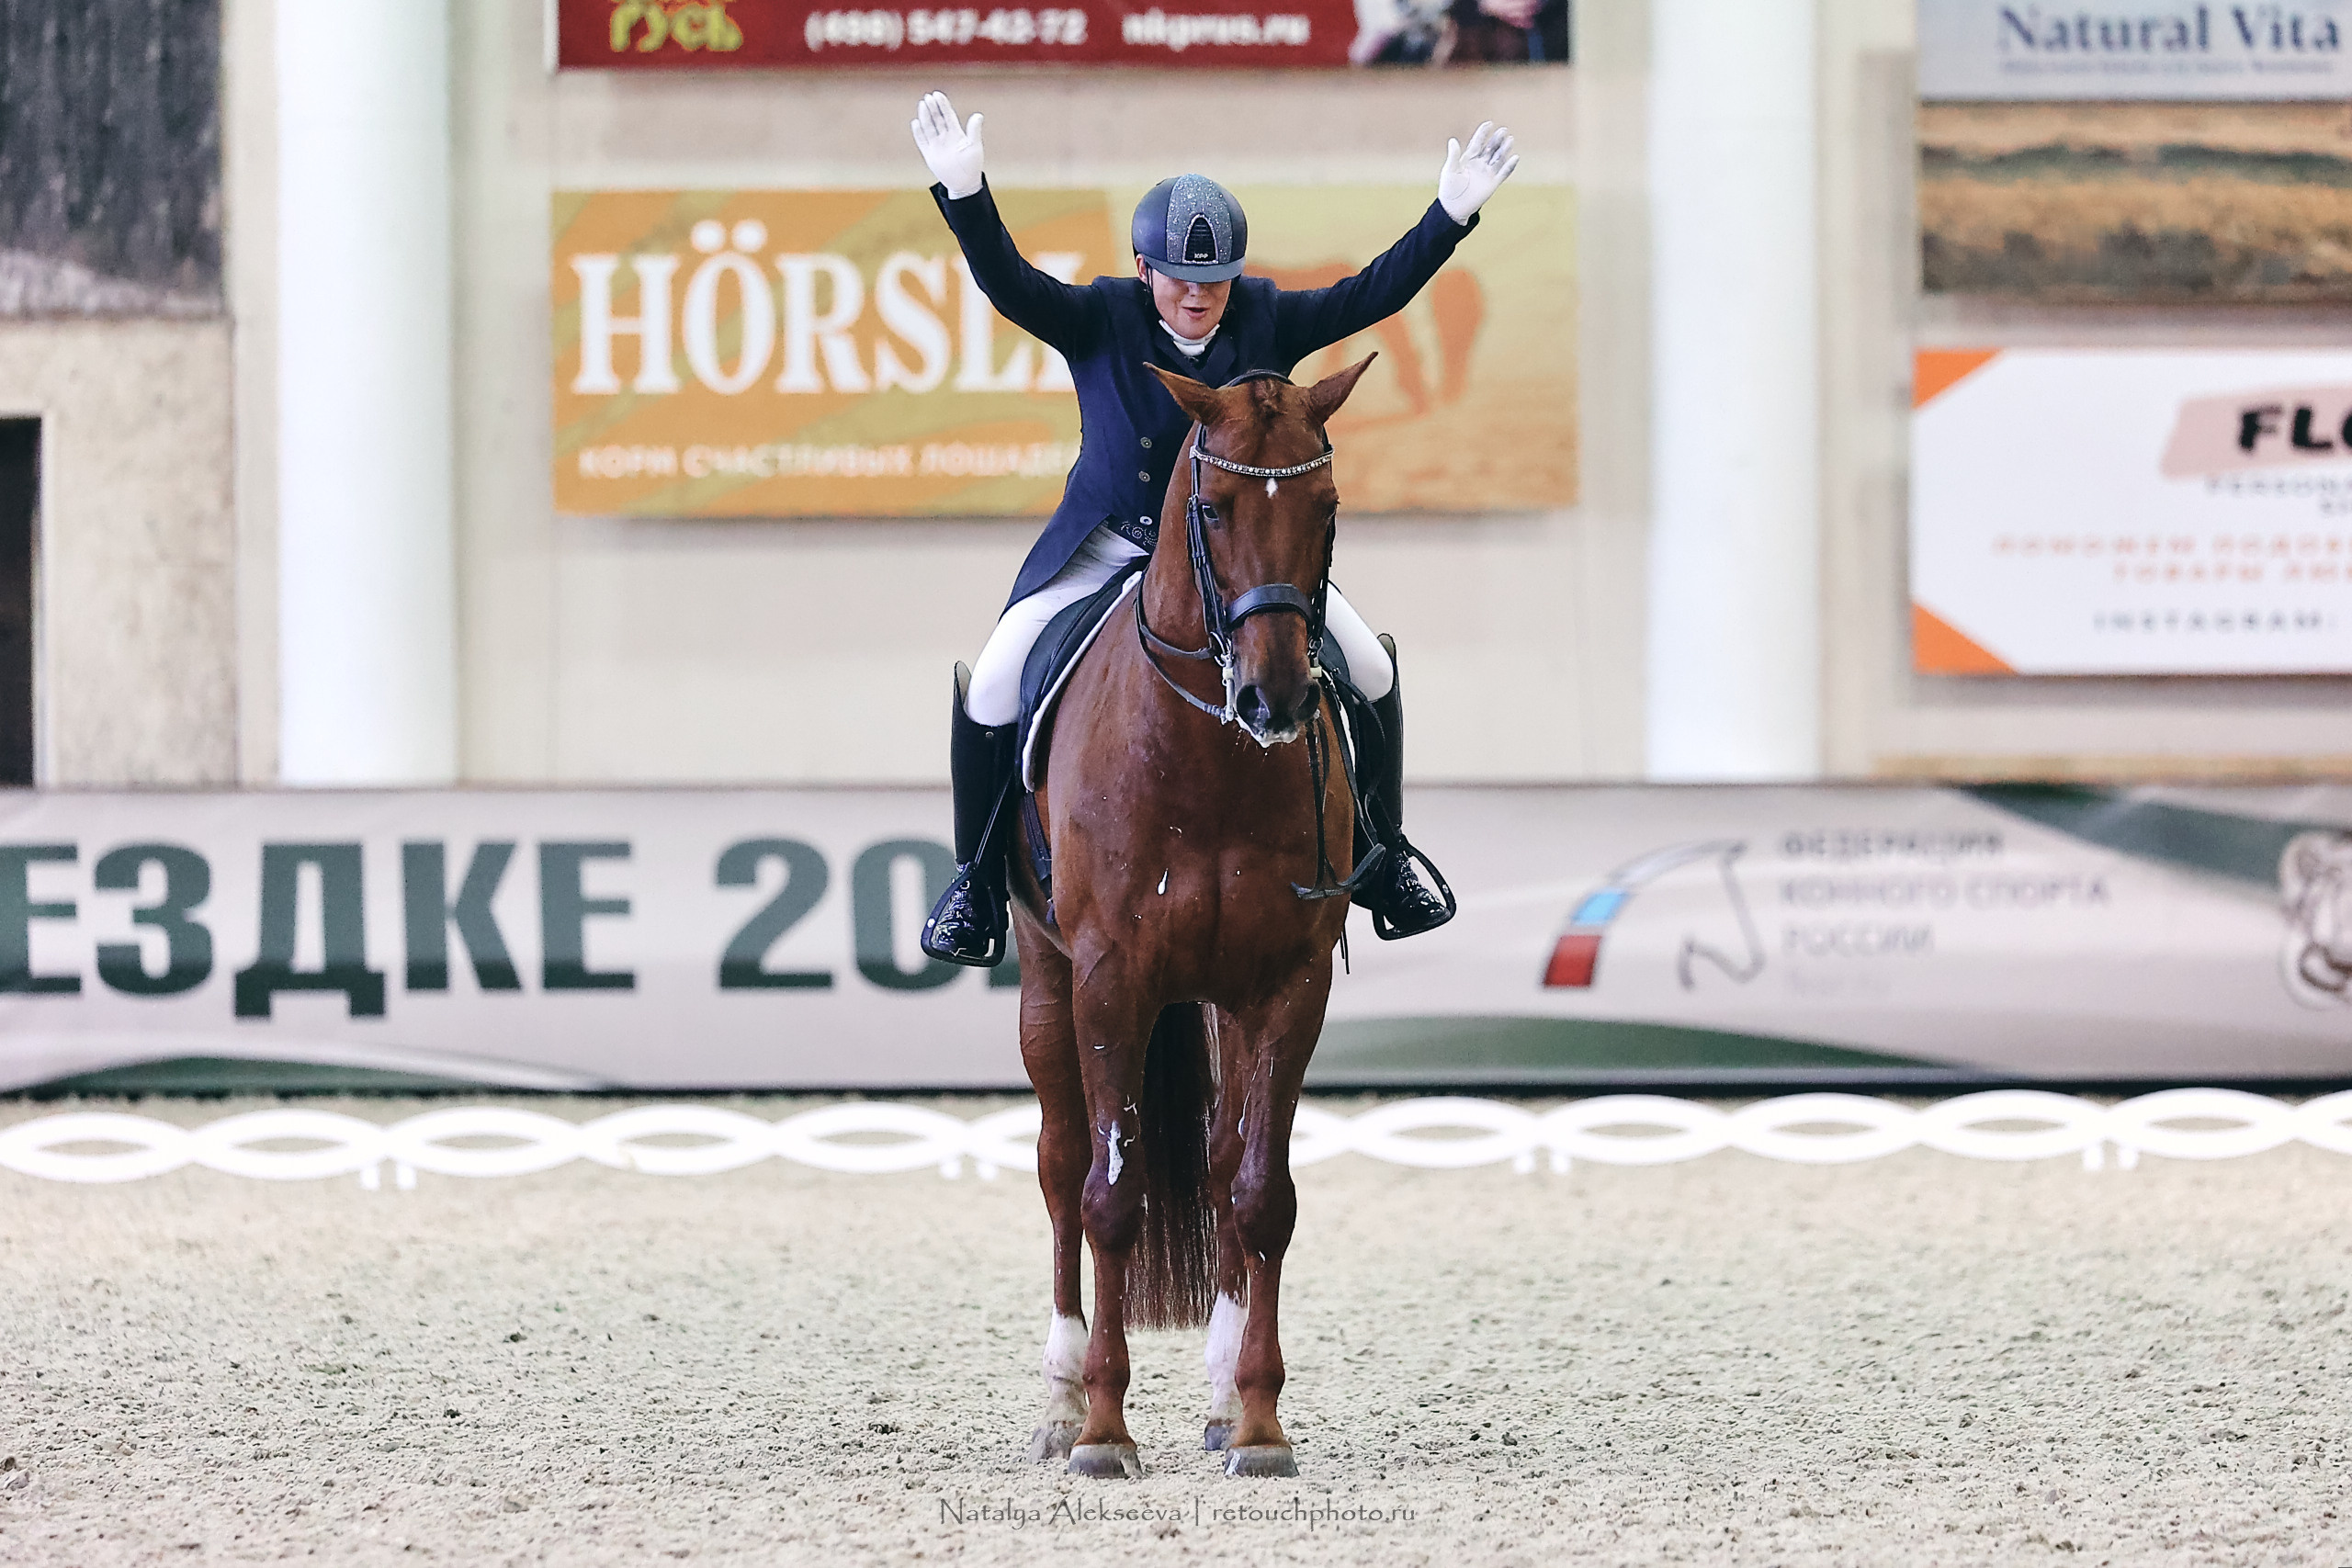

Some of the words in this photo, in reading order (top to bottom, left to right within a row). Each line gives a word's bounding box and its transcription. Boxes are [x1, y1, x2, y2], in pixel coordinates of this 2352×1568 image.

[1996, 2, 2211, 51] Natural
[2230, 4, 2341, 51] Vita
[2236, 402, 2352, 456] FL
[0, 841, 636, 1020] ЕЗДКЕ
[714, 837, 1019, 993] 20
